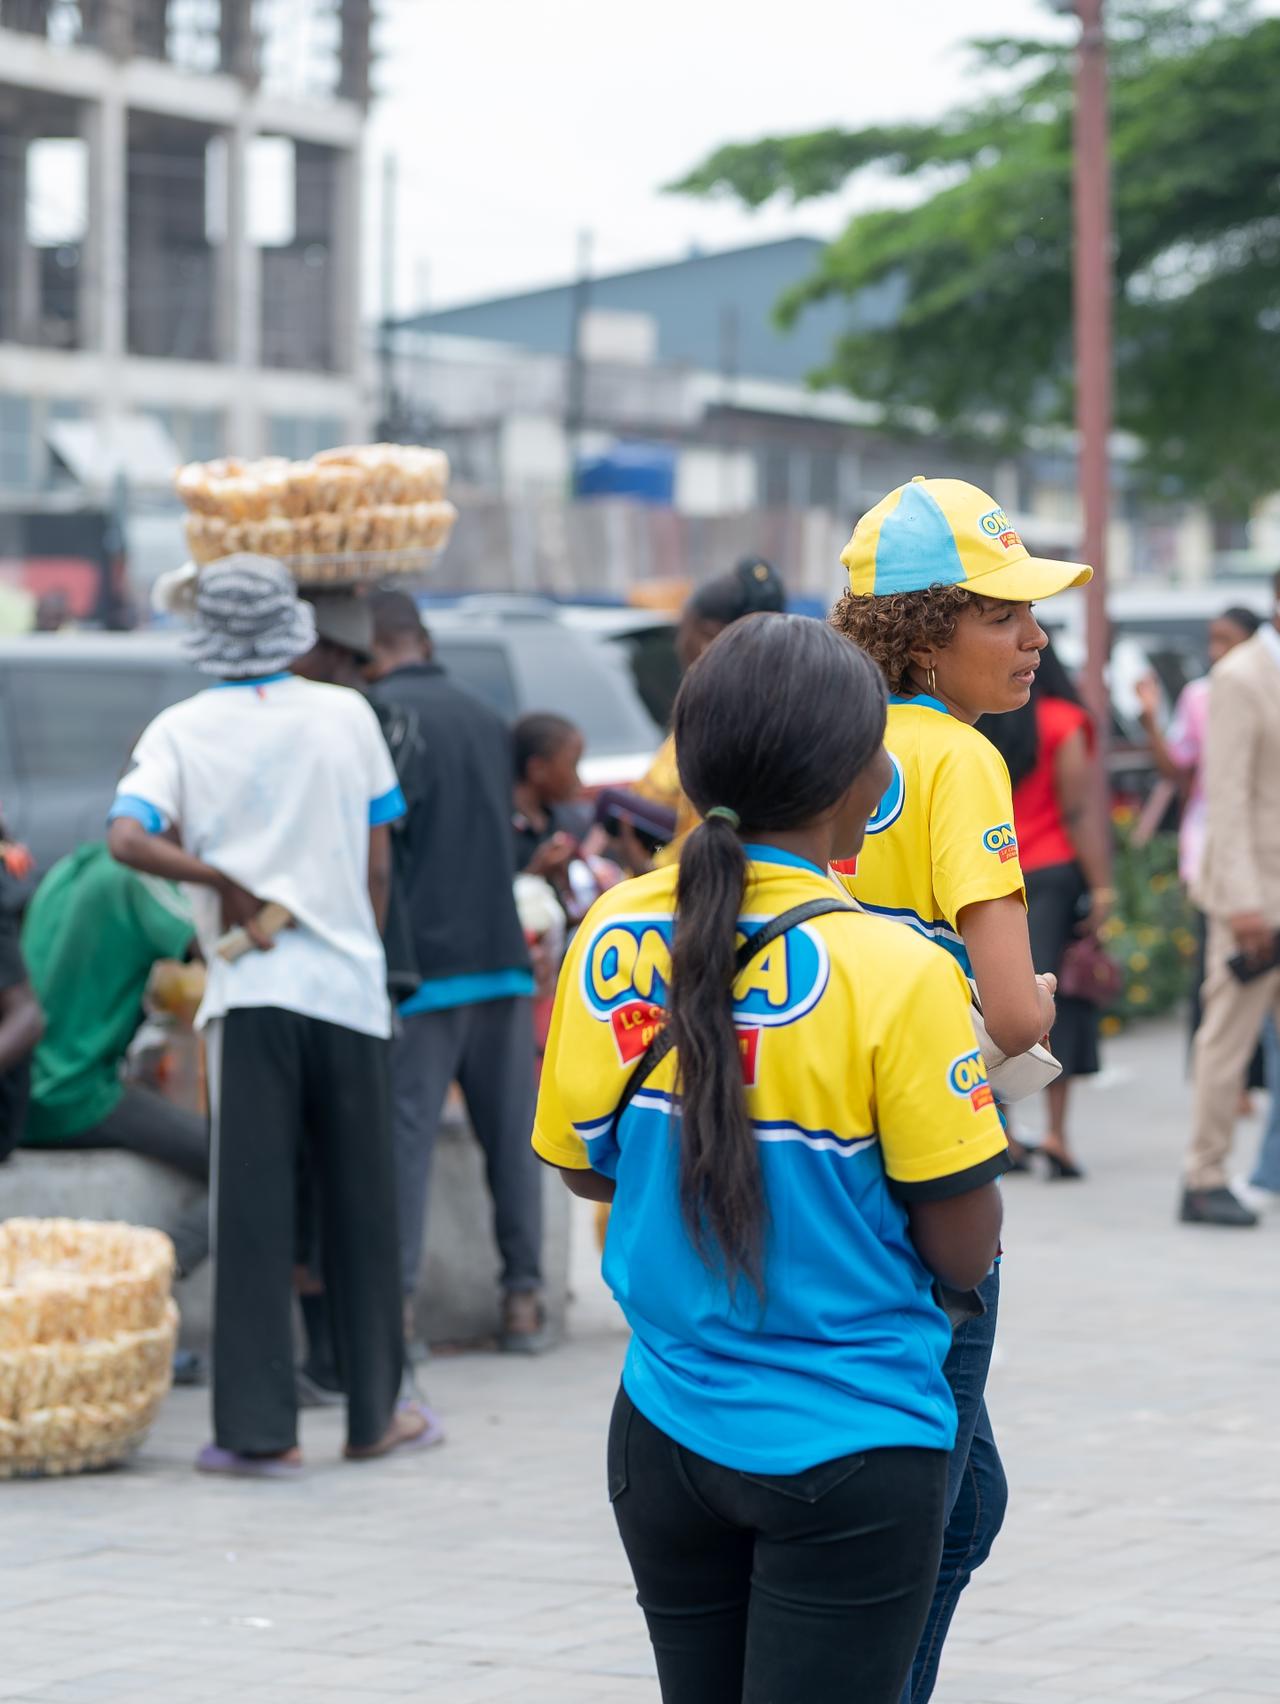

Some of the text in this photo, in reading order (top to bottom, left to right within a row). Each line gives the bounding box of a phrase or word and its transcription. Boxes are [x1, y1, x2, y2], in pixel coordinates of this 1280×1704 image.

[986, 826, 1016, 849] ON
[591, 927, 789, 1006] ONA
[620, 1010, 646, 1031] Le
[954, 1053, 988, 1091] ON
